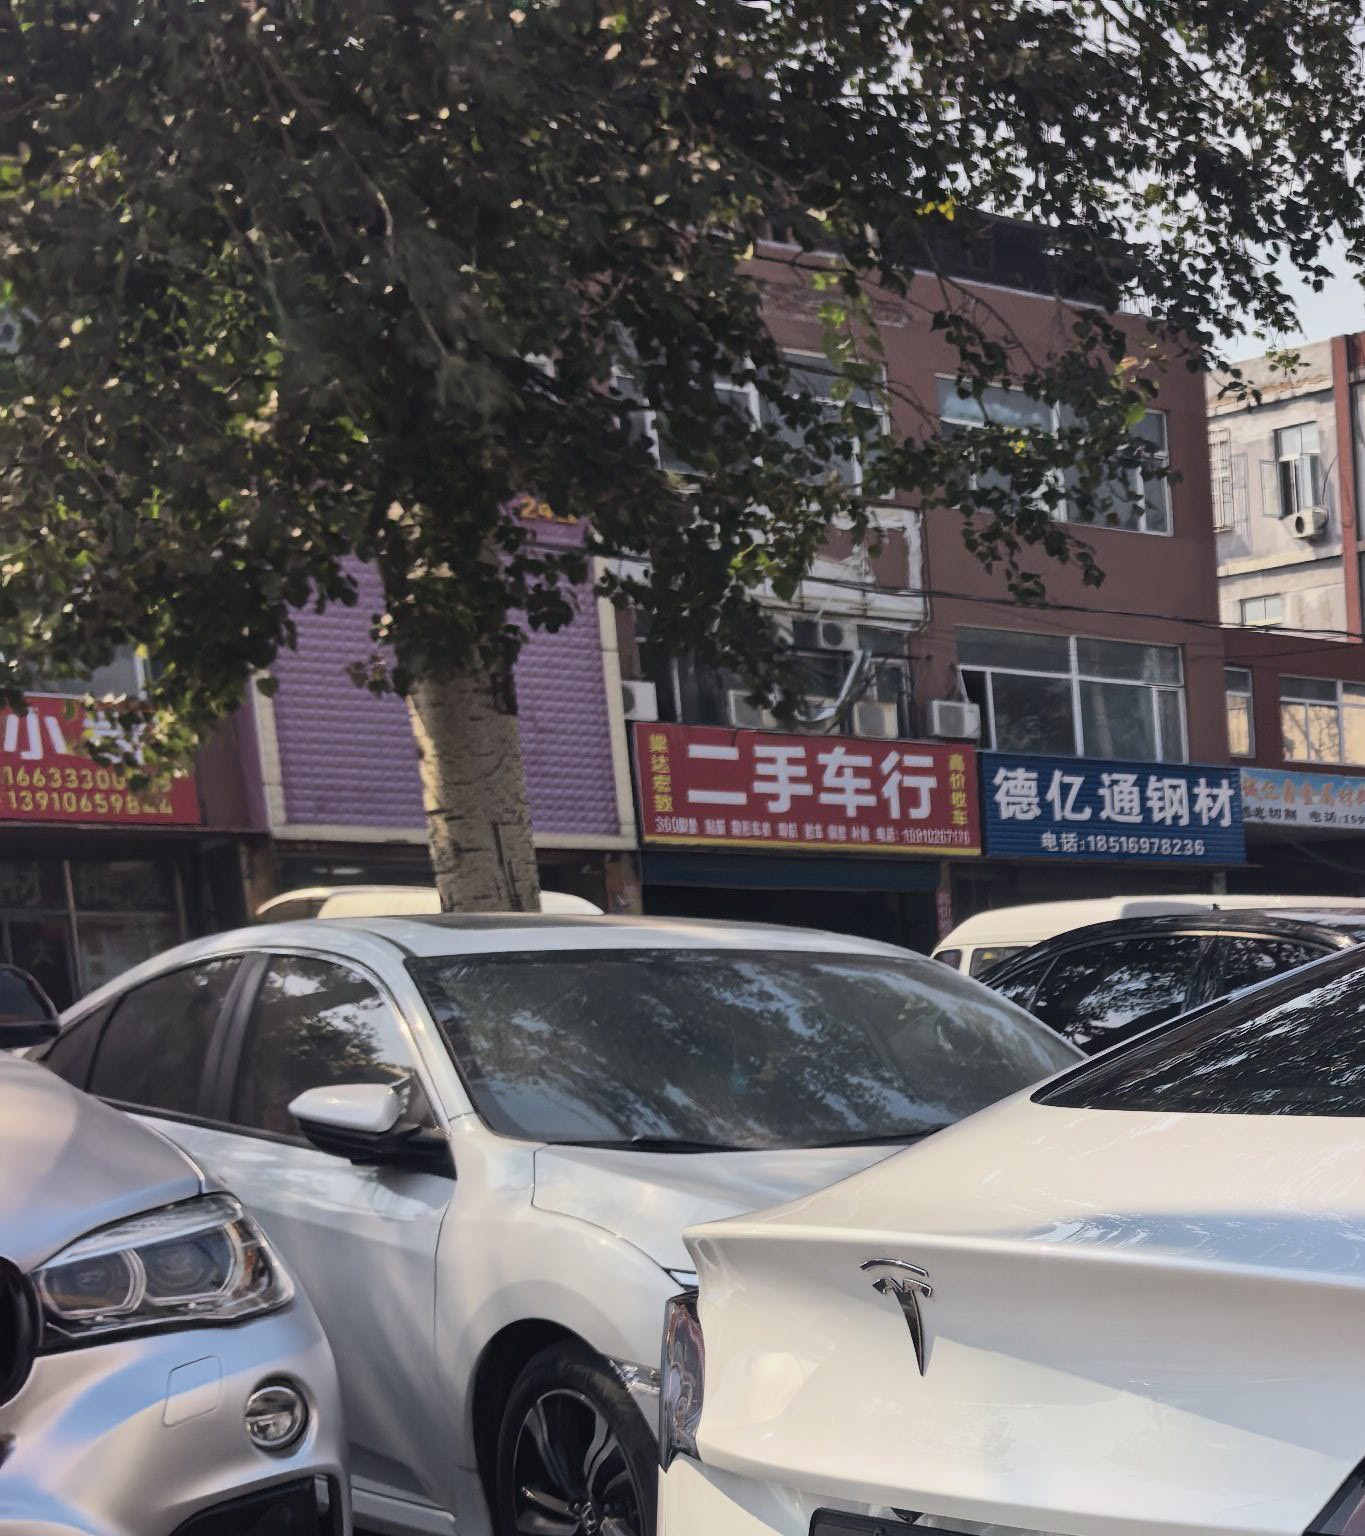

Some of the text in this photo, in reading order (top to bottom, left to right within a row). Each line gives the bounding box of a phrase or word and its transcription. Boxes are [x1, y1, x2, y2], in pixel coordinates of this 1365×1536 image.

[687, 744, 938, 820] 二手车行
[992, 766, 1236, 828] 德亿通钢材
[1040, 831, 1206, 856] 电话:18516978236
